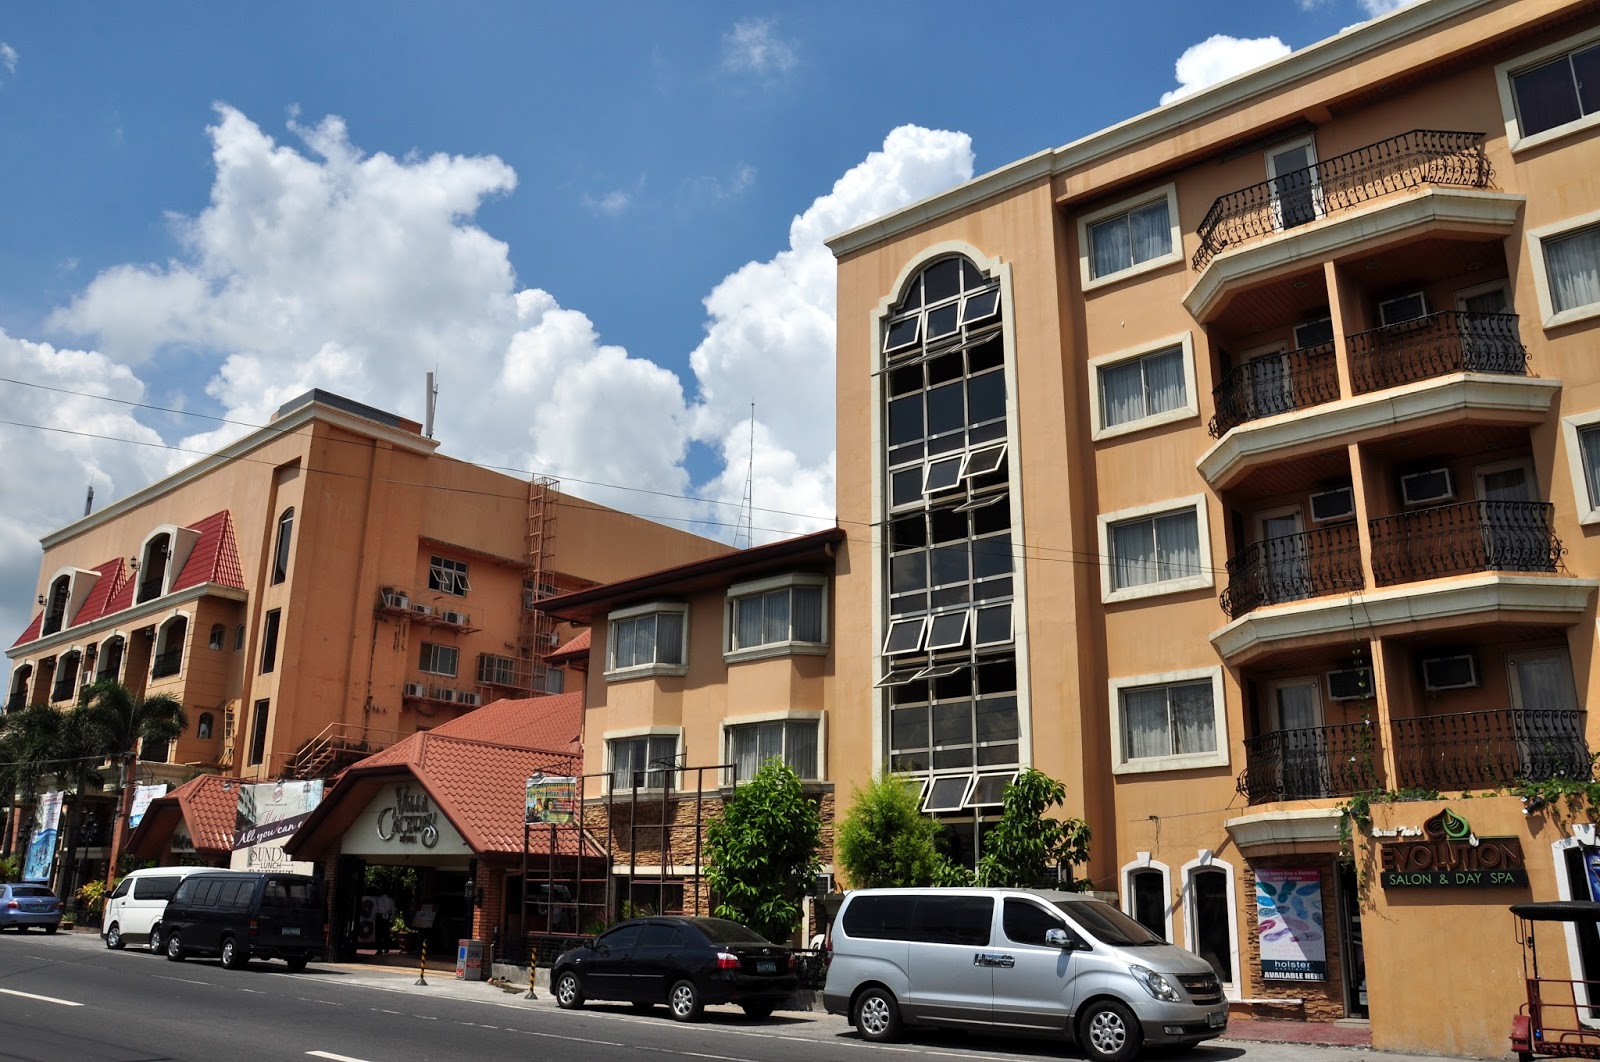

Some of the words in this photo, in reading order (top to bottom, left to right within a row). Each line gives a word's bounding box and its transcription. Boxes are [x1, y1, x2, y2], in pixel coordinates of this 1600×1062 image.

[236, 828, 256, 846] All
[256, 829, 276, 844] you
[276, 824, 297, 834] can
[250, 846, 289, 862] SUNDA
[1381, 843, 1521, 870] EVOLUTION
[260, 861, 281, 869] LUNCH
[1389, 873, 1432, 885] SALON
[1439, 873, 1449, 884] &
[1455, 872, 1482, 884] DAY
[1490, 872, 1515, 883] SPA
[1274, 960, 1311, 968] holster
[1264, 971, 1304, 979] AVAILABLE
[1304, 972, 1325, 980] HERE
